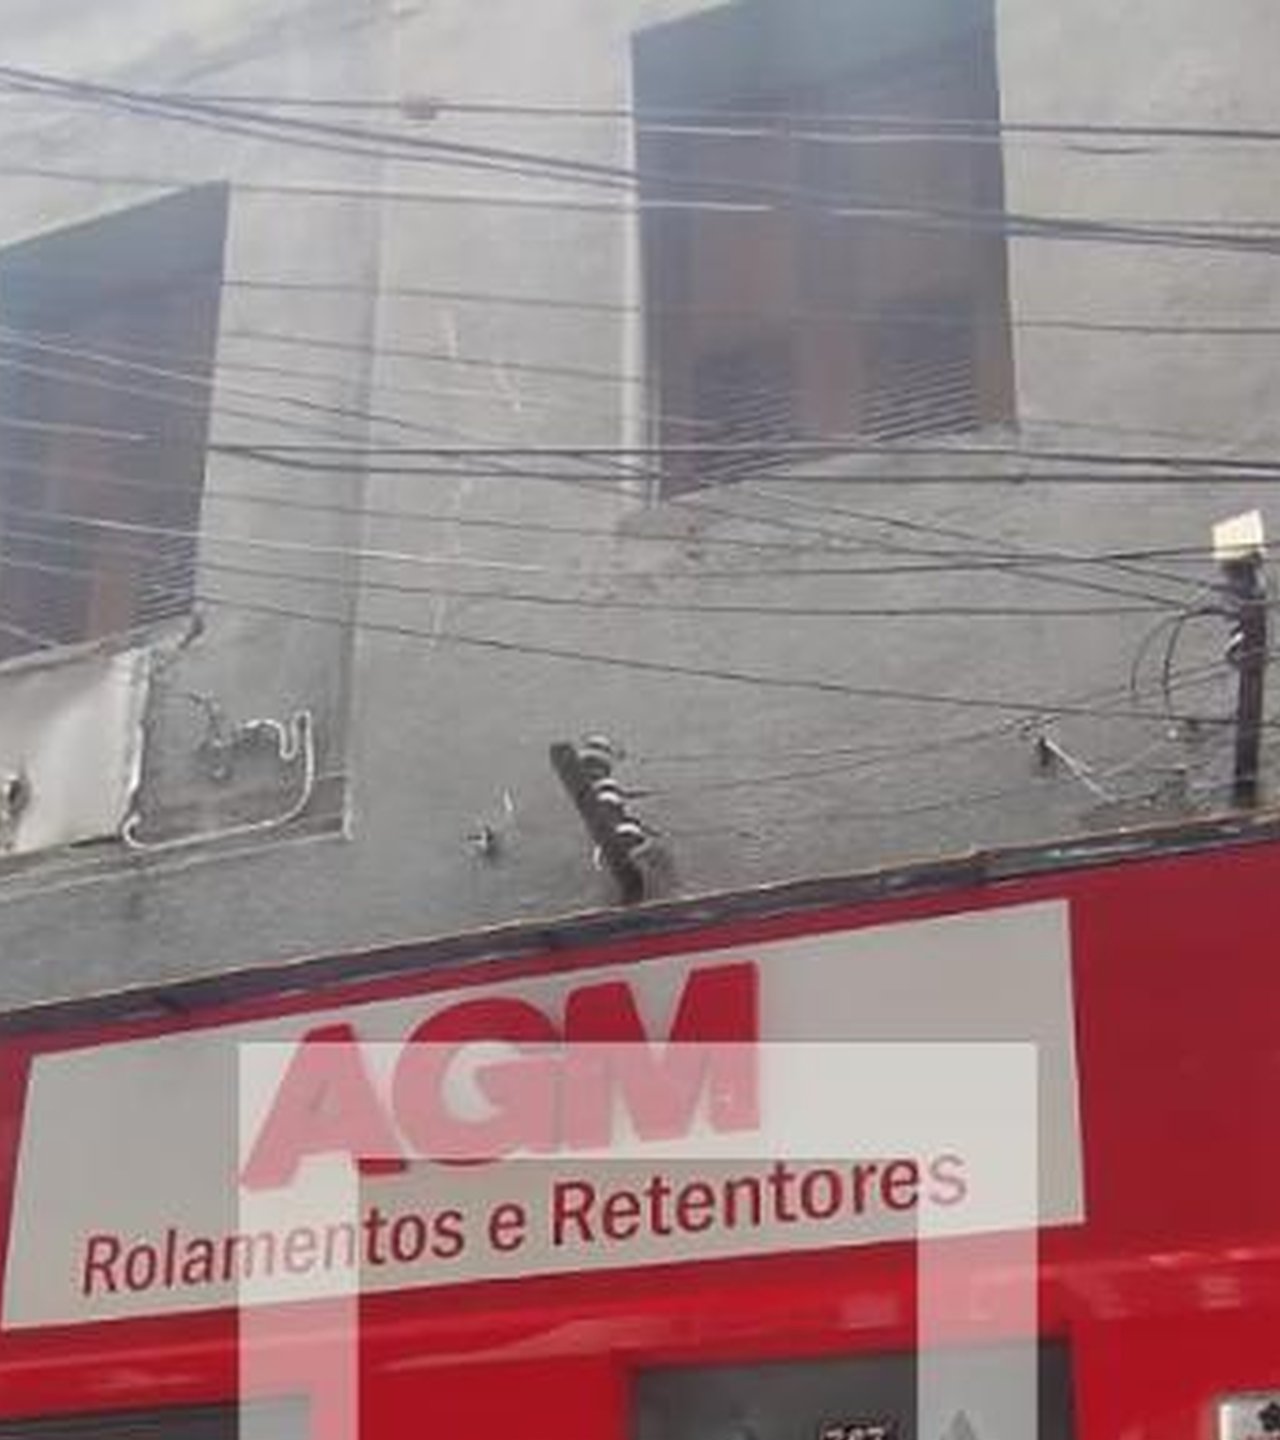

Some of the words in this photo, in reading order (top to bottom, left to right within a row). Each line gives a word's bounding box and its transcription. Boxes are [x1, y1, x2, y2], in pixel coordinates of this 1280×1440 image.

[239, 961, 762, 1193] AGM
[81, 1201, 464, 1298] Rolamentos
[488, 1204, 527, 1252] e
[552, 1150, 968, 1247] Retentores
